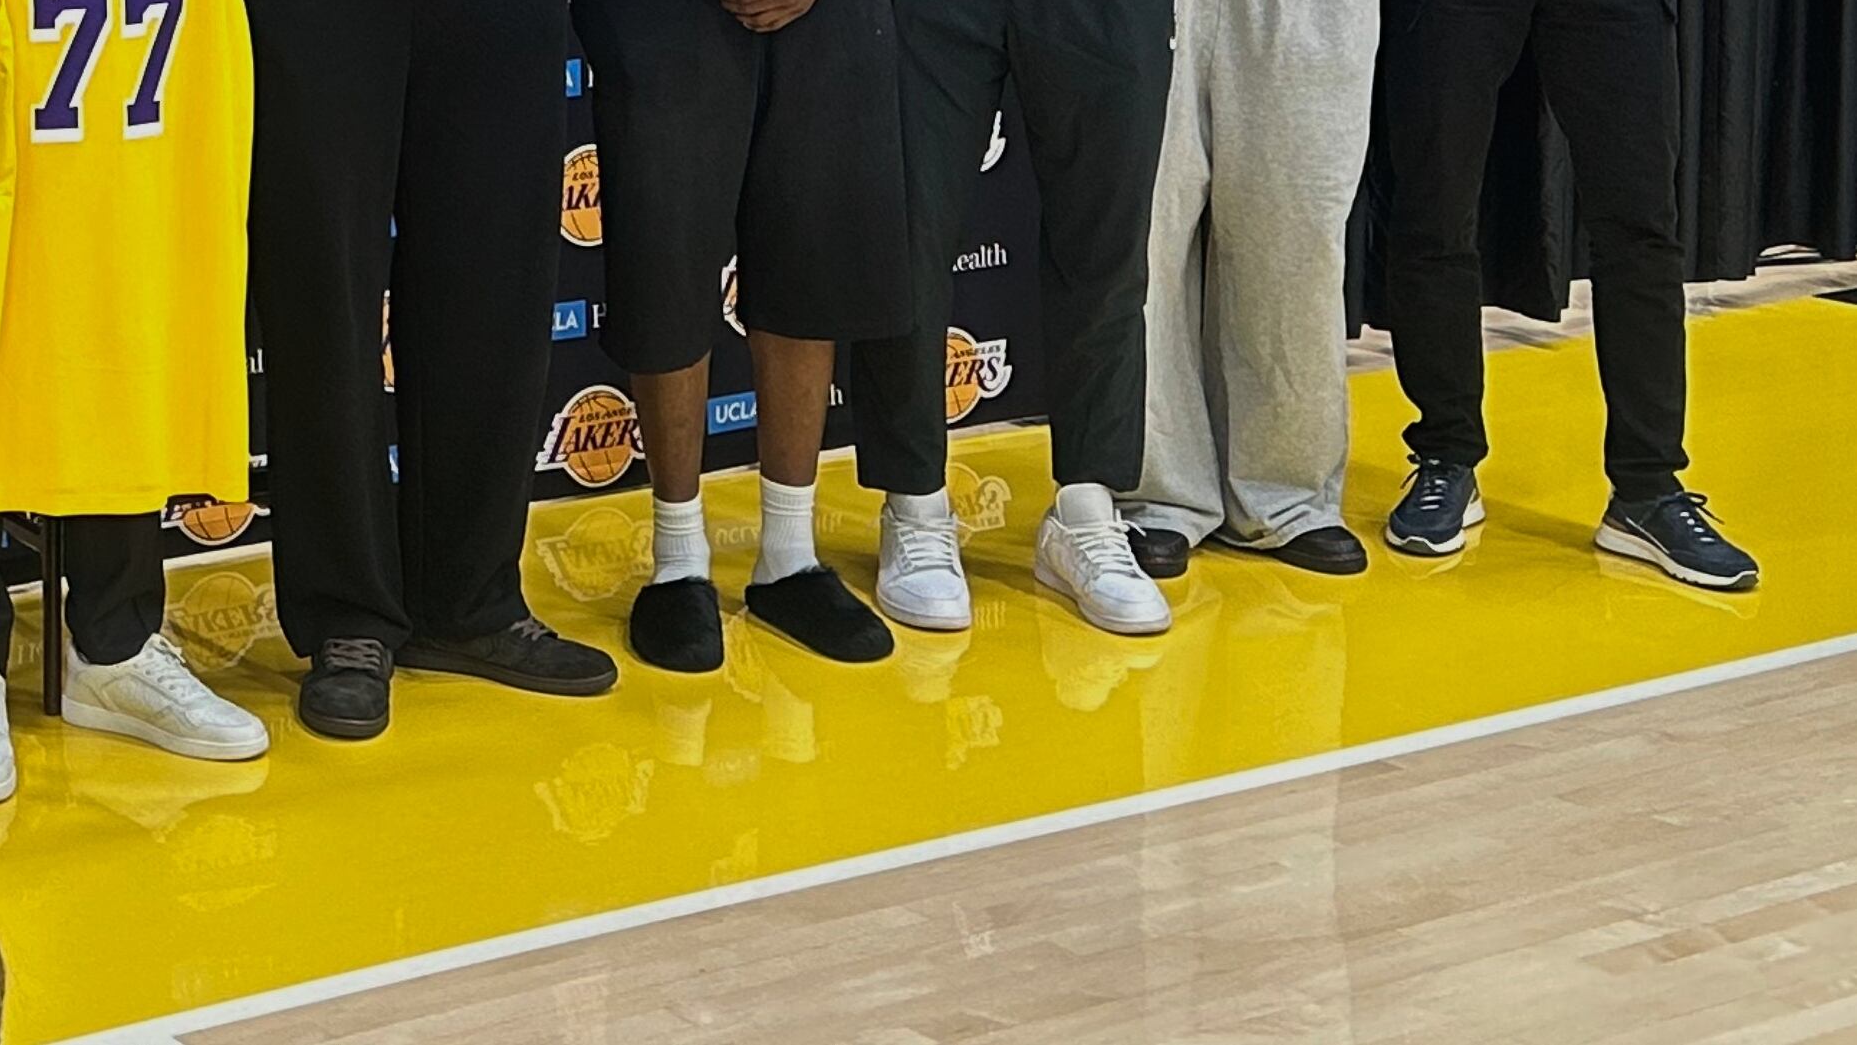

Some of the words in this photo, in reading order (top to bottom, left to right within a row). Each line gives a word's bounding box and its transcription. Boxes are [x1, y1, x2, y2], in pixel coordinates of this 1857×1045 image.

[957, 243, 1007, 271] ealth
[552, 308, 578, 331] LA
[947, 357, 1000, 391] ERS
[548, 416, 642, 459] LAKER
